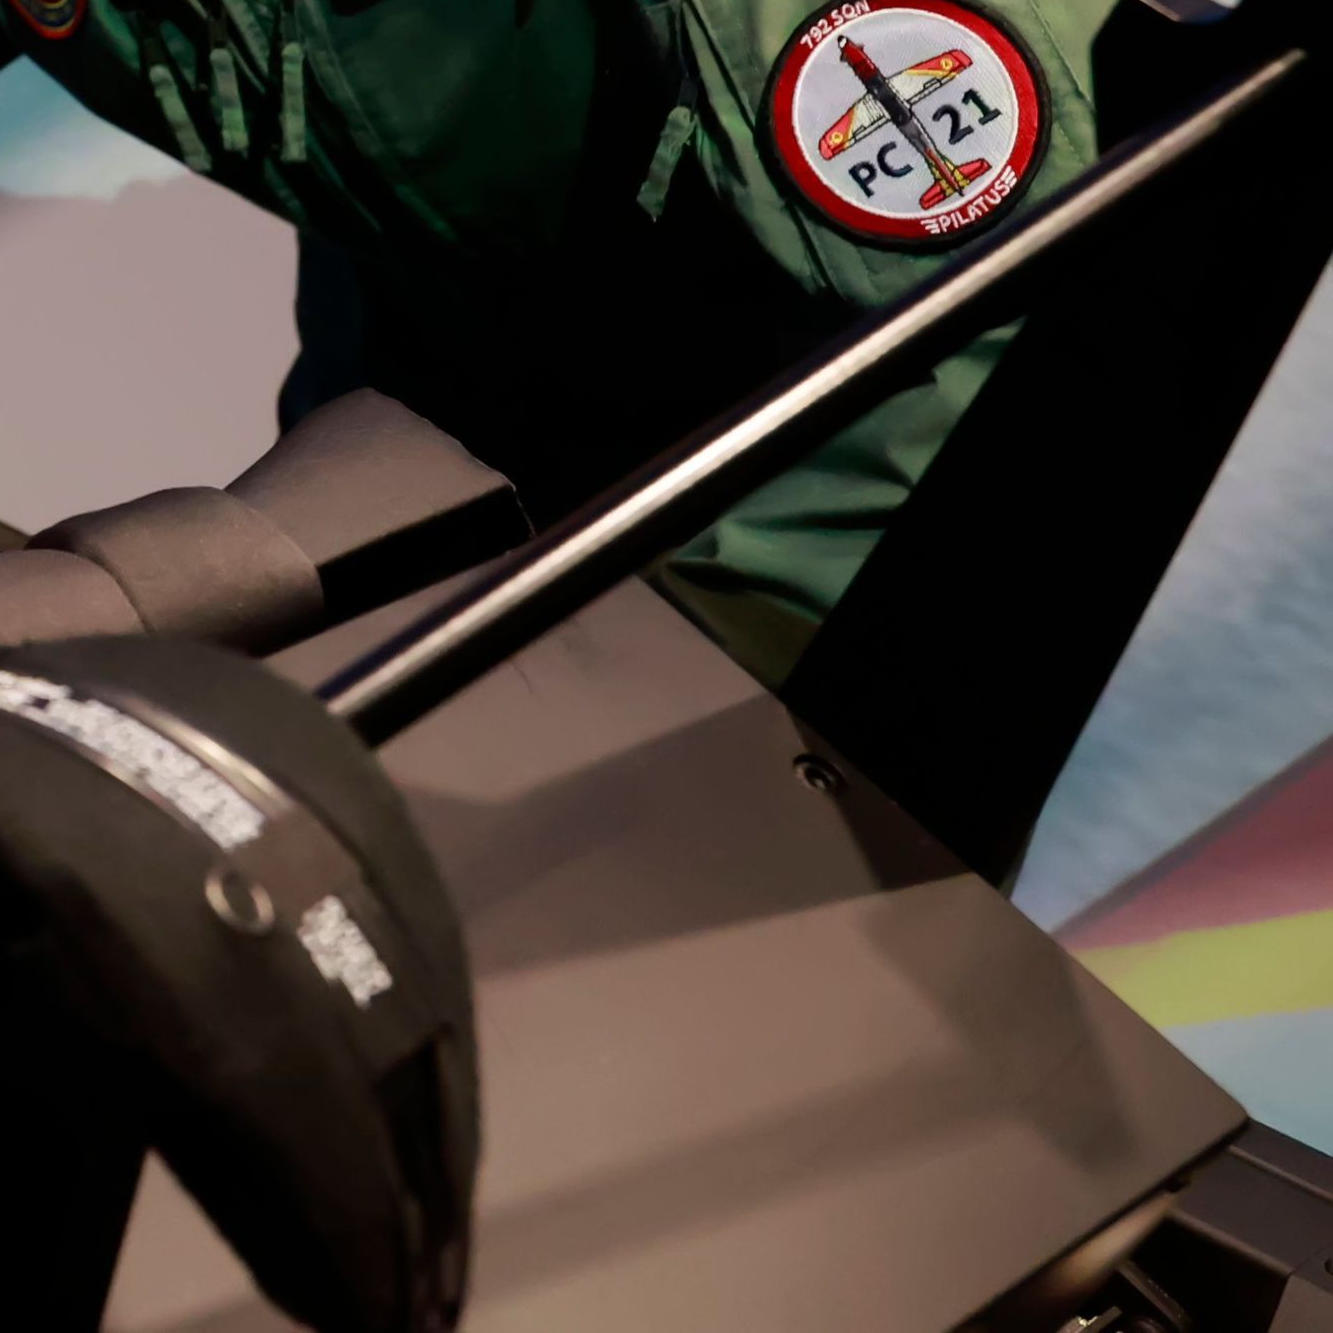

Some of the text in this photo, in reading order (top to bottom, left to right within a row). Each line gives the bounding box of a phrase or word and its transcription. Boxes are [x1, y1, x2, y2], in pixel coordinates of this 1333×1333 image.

[800, 0, 871, 49] 792 SQN
[848, 88, 1002, 198] PC 21
[938, 179, 1010, 232] PILATUS
